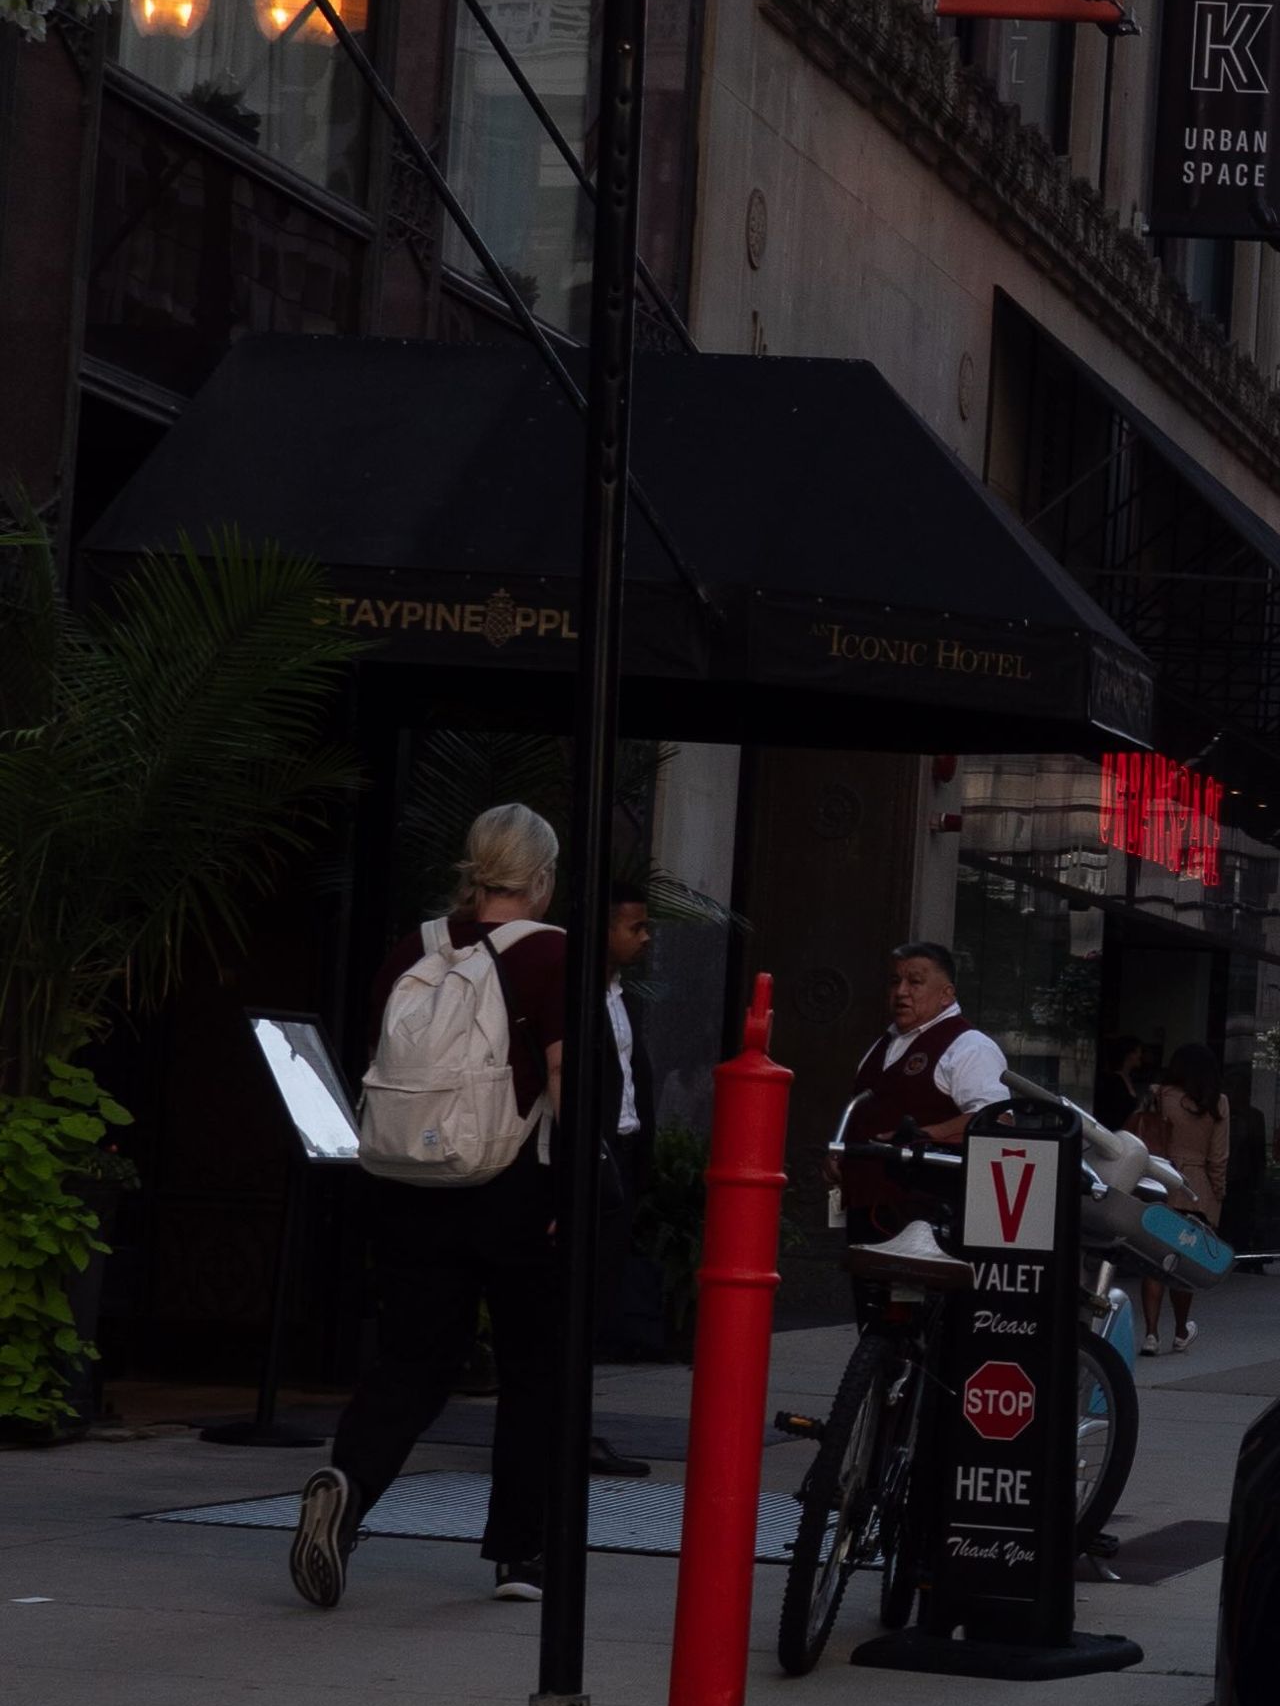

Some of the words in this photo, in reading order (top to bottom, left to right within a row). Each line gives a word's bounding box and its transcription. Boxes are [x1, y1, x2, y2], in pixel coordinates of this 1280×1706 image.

[1184, 127, 1268, 153] URBAN
[1182, 160, 1266, 187] SPACE
[991, 1160, 1036, 1242] V
[969, 1261, 1045, 1293] VALET
[972, 1310, 1038, 1335] Please
[967, 1387, 1033, 1417] STOP
[955, 1465, 1032, 1506] HERE
[946, 1536, 999, 1559] Thank
[1002, 1540, 1036, 1568] You
